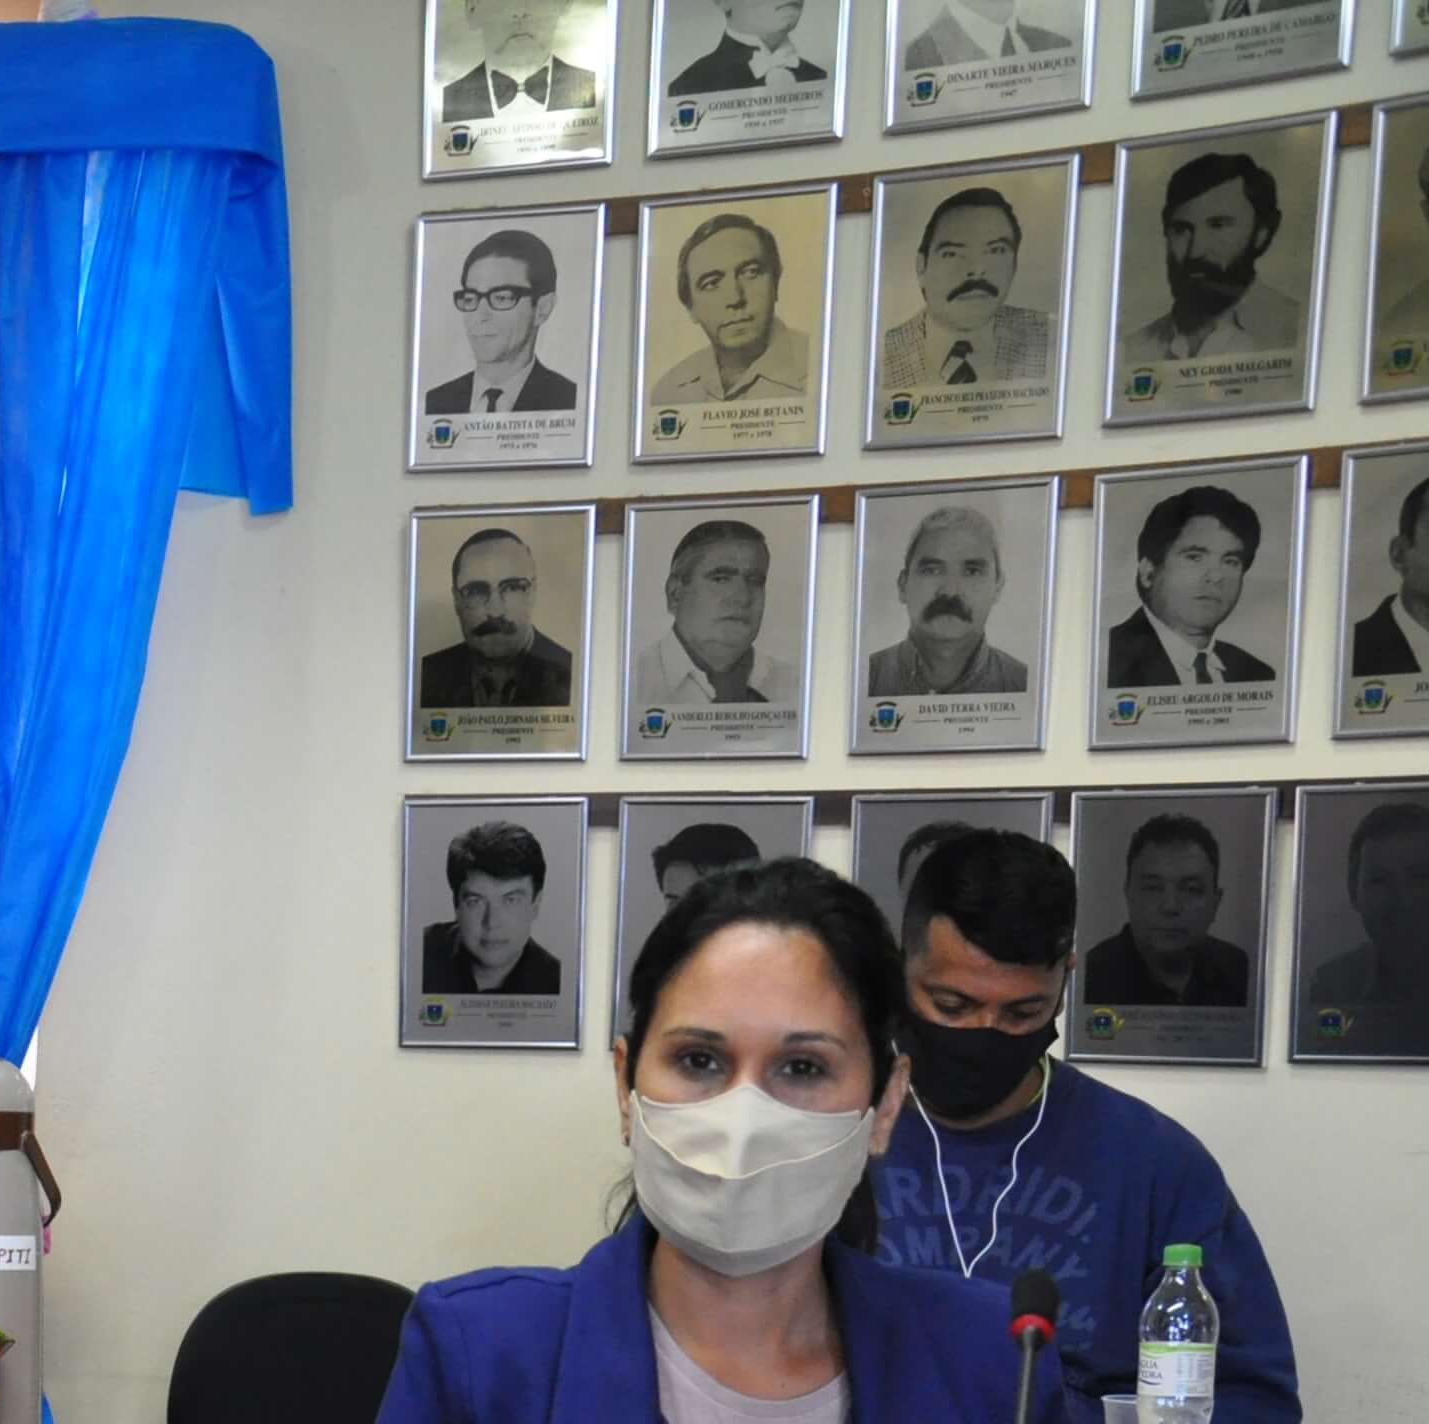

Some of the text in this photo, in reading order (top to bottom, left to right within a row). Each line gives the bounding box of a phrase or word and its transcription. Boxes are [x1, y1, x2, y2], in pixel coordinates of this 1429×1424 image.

[947, 56, 1076, 83] DINARTE VIEIRA MARQUES
[985, 77, 1033, 89] PRESIDENTE
[775, 90, 824, 103] MEDEIROS
[742, 108, 787, 119] PRESIDENTE
[496, 418, 533, 430] BATISTA
[535, 419, 547, 429] DE
[1222, 693, 1233, 703] DE
[1236, 690, 1274, 701] MORAIS
[918, 702, 1016, 714] DAVID TERRA VIEIRA
